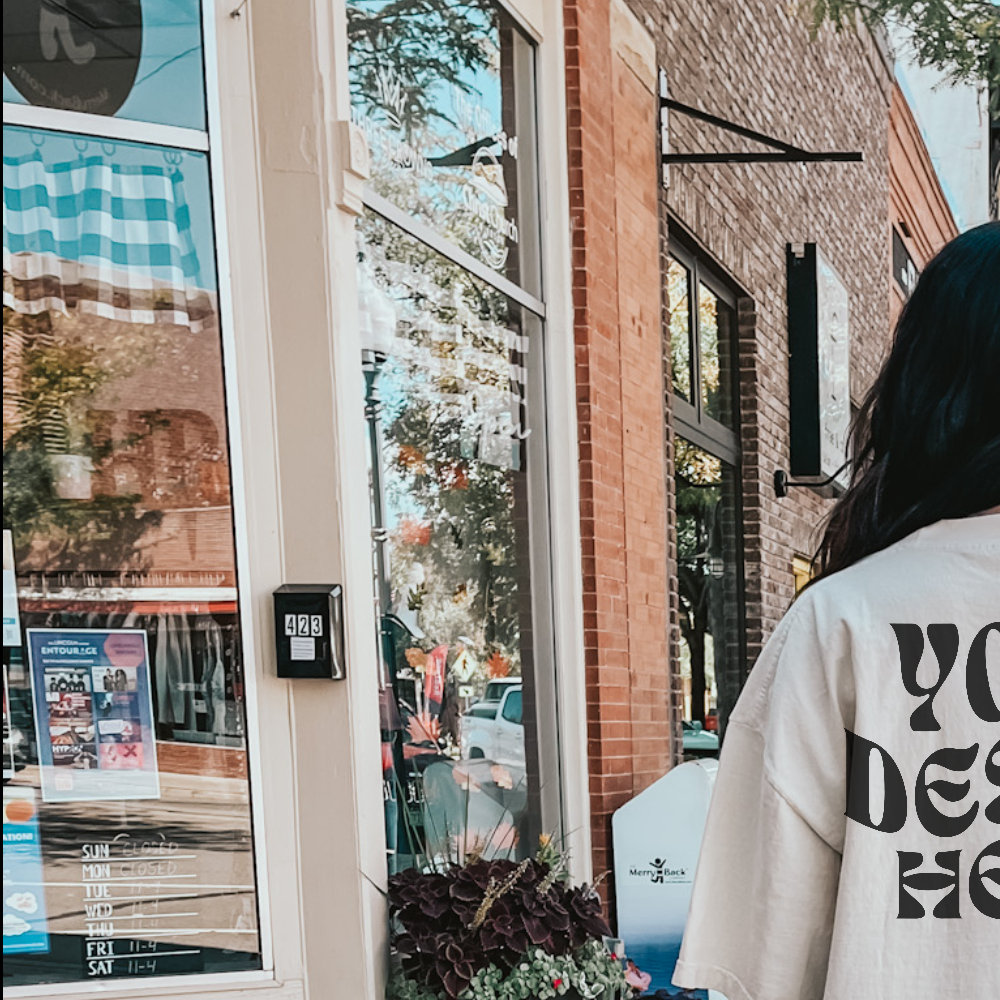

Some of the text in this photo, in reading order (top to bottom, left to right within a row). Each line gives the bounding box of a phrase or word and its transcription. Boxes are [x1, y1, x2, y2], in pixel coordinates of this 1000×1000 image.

[286, 615, 321, 635] 423
[81, 841, 179, 859] SUN CLOSED
[82, 861, 178, 879] MON CLOSED
[629, 868, 686, 878] Merry Back
[84, 884, 112, 898] TUE
[85, 903, 113, 918] WED
[86, 921, 114, 938] THU
[86, 940, 157, 958] FRI 11-4
[87, 959, 157, 976] SAT 11-4
